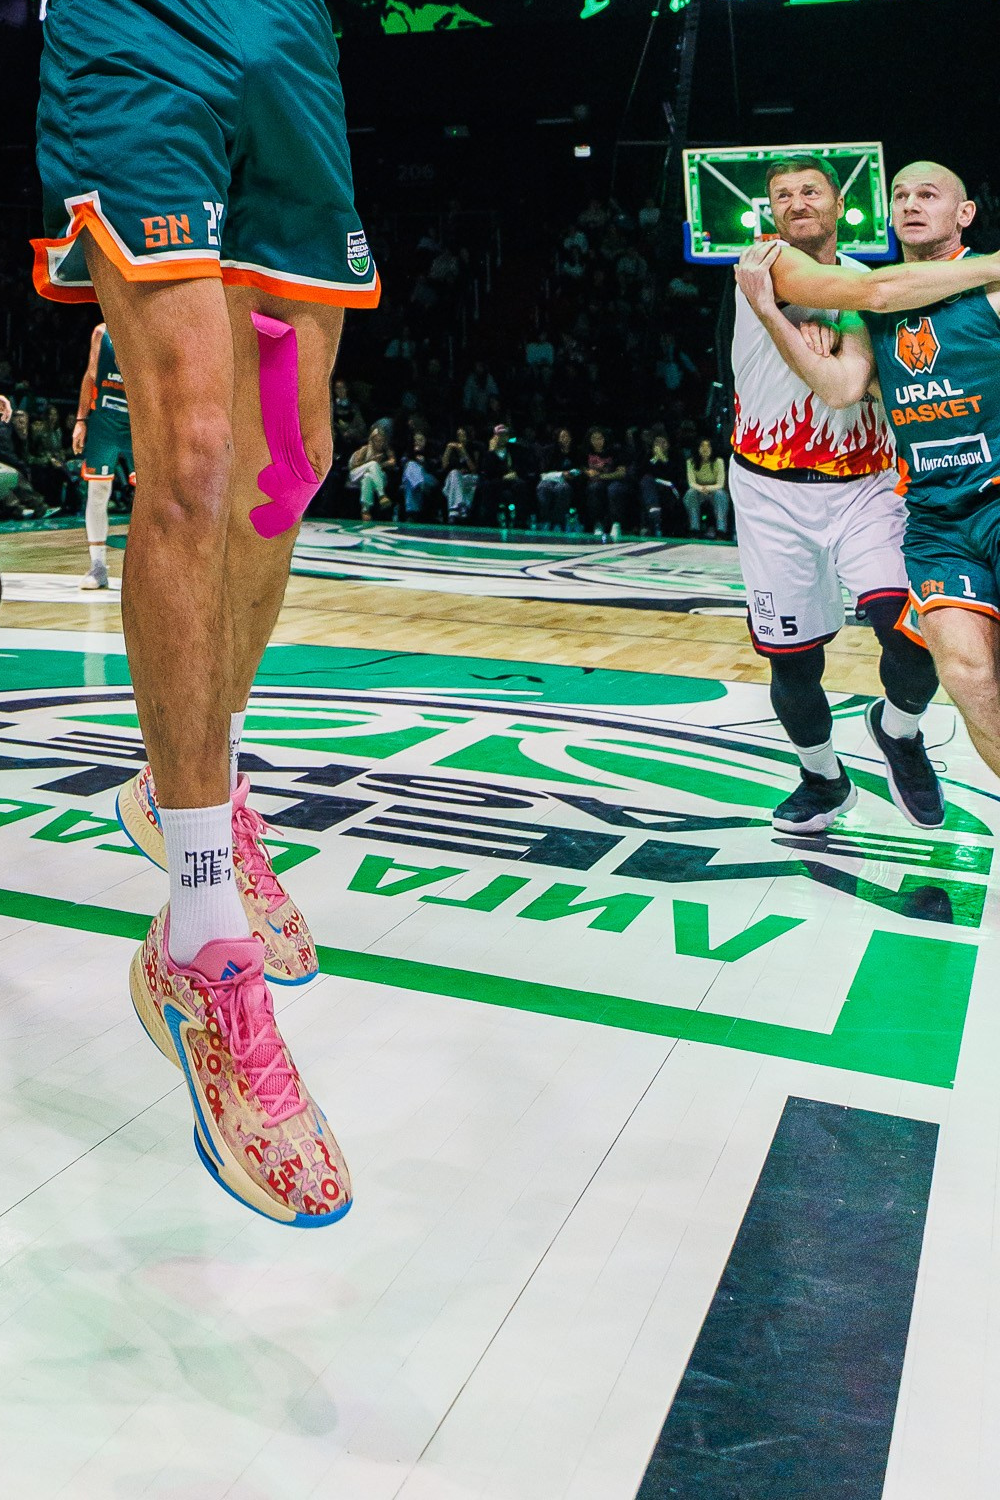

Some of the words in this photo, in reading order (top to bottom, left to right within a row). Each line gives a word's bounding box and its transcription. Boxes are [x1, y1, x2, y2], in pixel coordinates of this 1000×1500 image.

[895, 378, 964, 405] URAL
[891, 394, 983, 427] BASKET
[958, 575, 977, 599] 1
[780, 615, 799, 637] 5
[185, 847, 229, 865] МЯЧ
